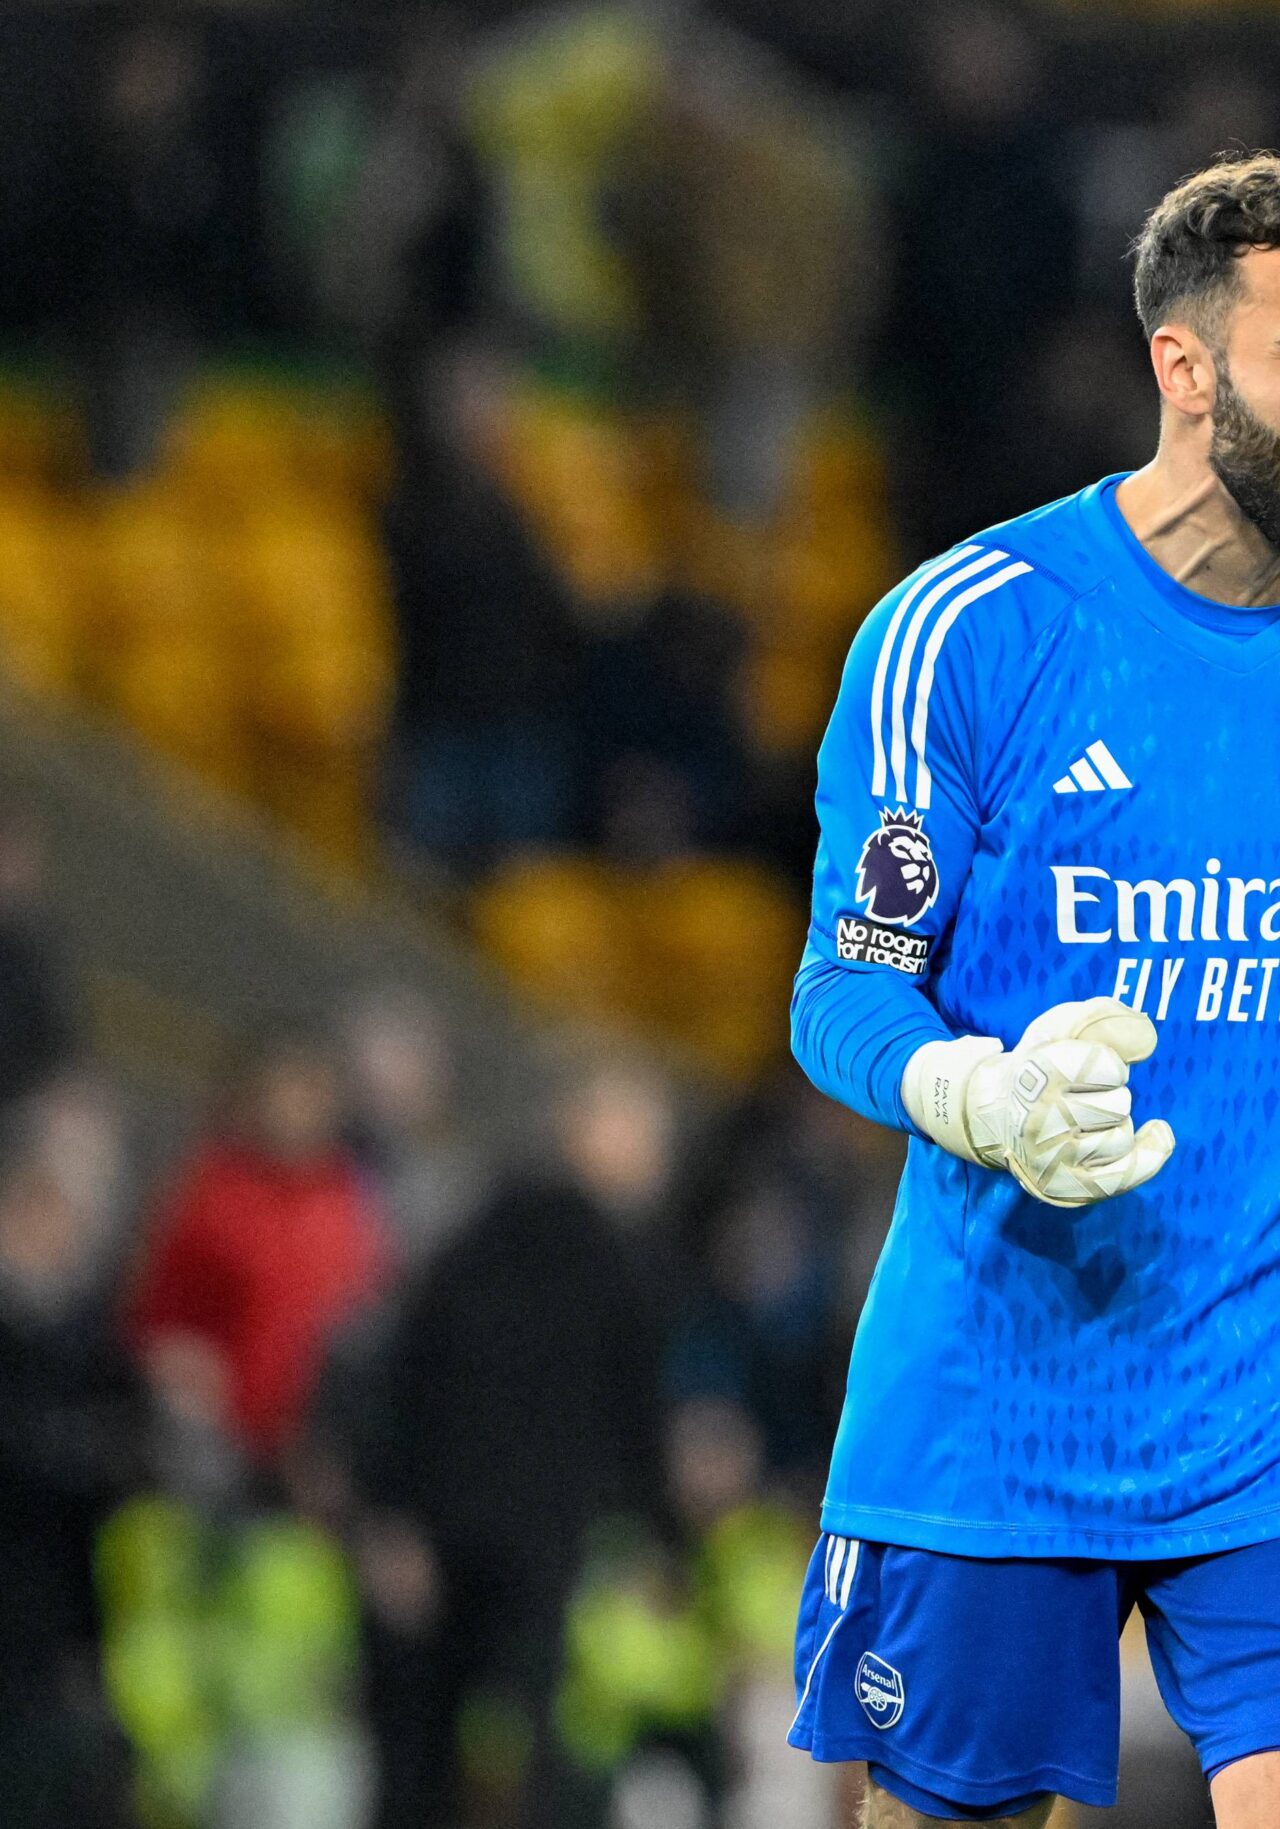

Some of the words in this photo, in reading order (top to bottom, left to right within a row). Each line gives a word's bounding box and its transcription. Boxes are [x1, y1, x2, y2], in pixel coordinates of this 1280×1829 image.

[837, 918, 868, 942] No
[870, 927, 928, 956] room
[837, 936, 864, 960] for
[864, 946, 929, 974] racism
[1112, 957, 1185, 1021] FLY
[861, 1663, 895, 1690] Arsenal
